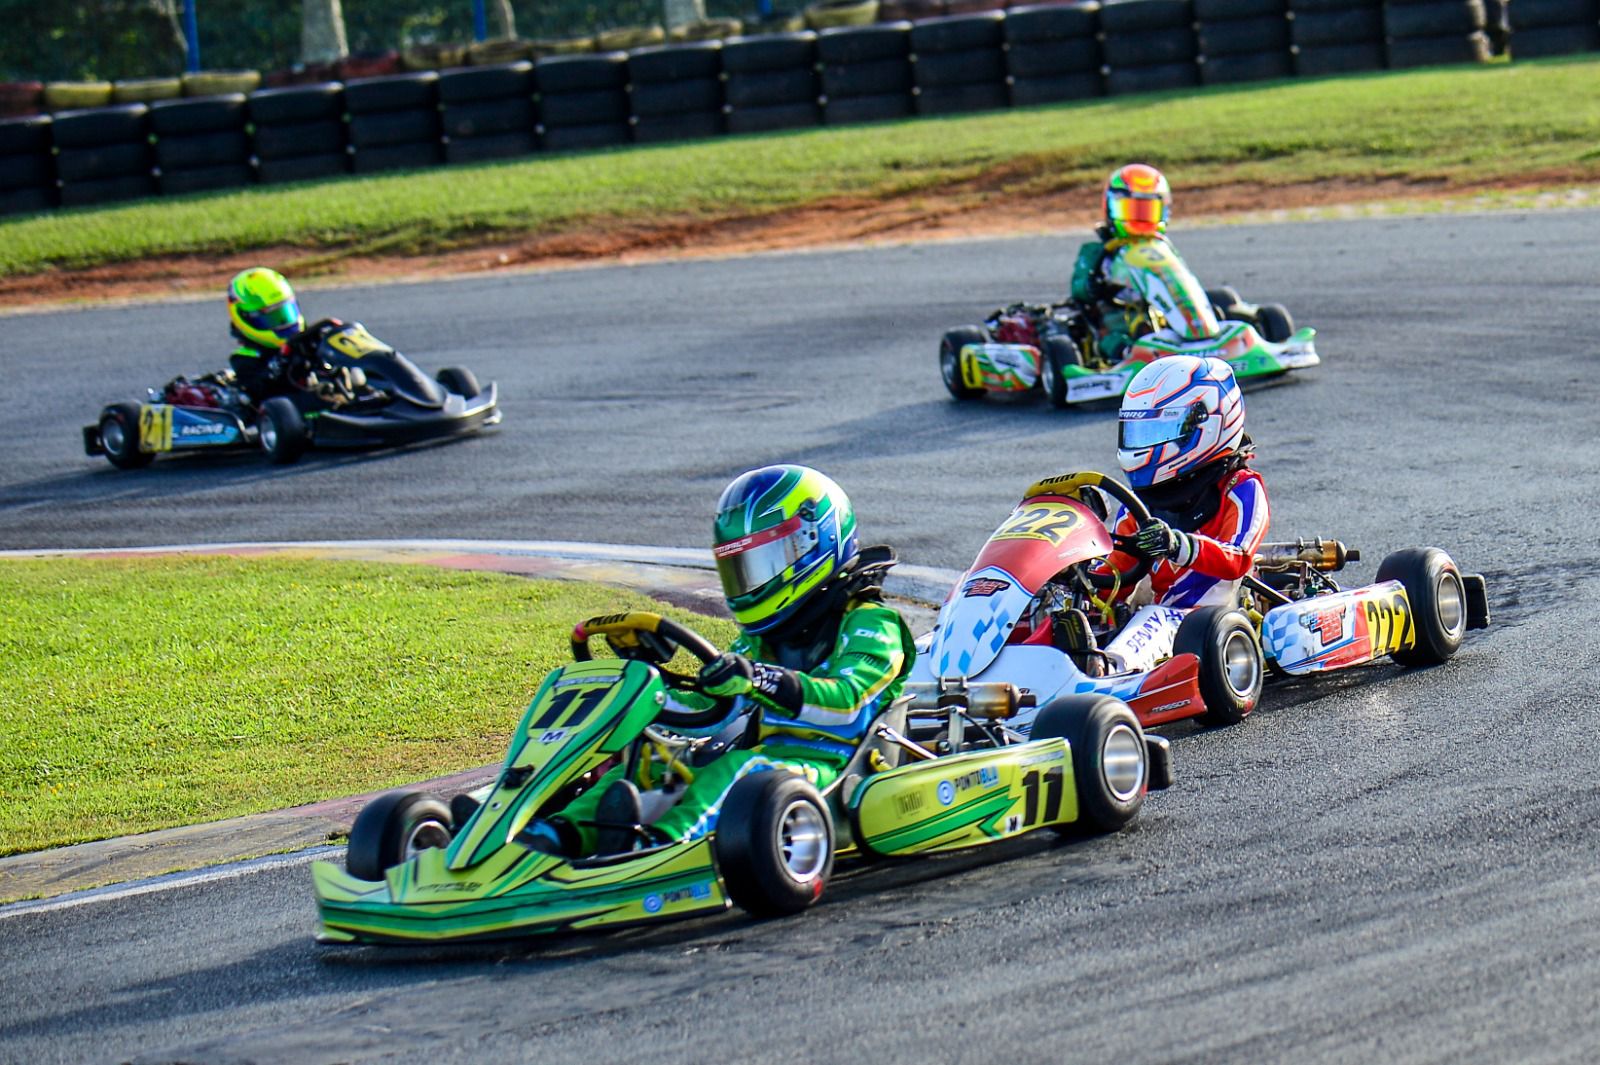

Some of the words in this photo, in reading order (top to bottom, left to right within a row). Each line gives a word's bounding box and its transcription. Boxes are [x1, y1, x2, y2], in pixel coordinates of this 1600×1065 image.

[182, 423, 223, 435] RACING
[1366, 593, 1413, 657] 222
[529, 687, 612, 730] 11
[541, 731, 565, 742] M
[1021, 765, 1064, 828] 11
